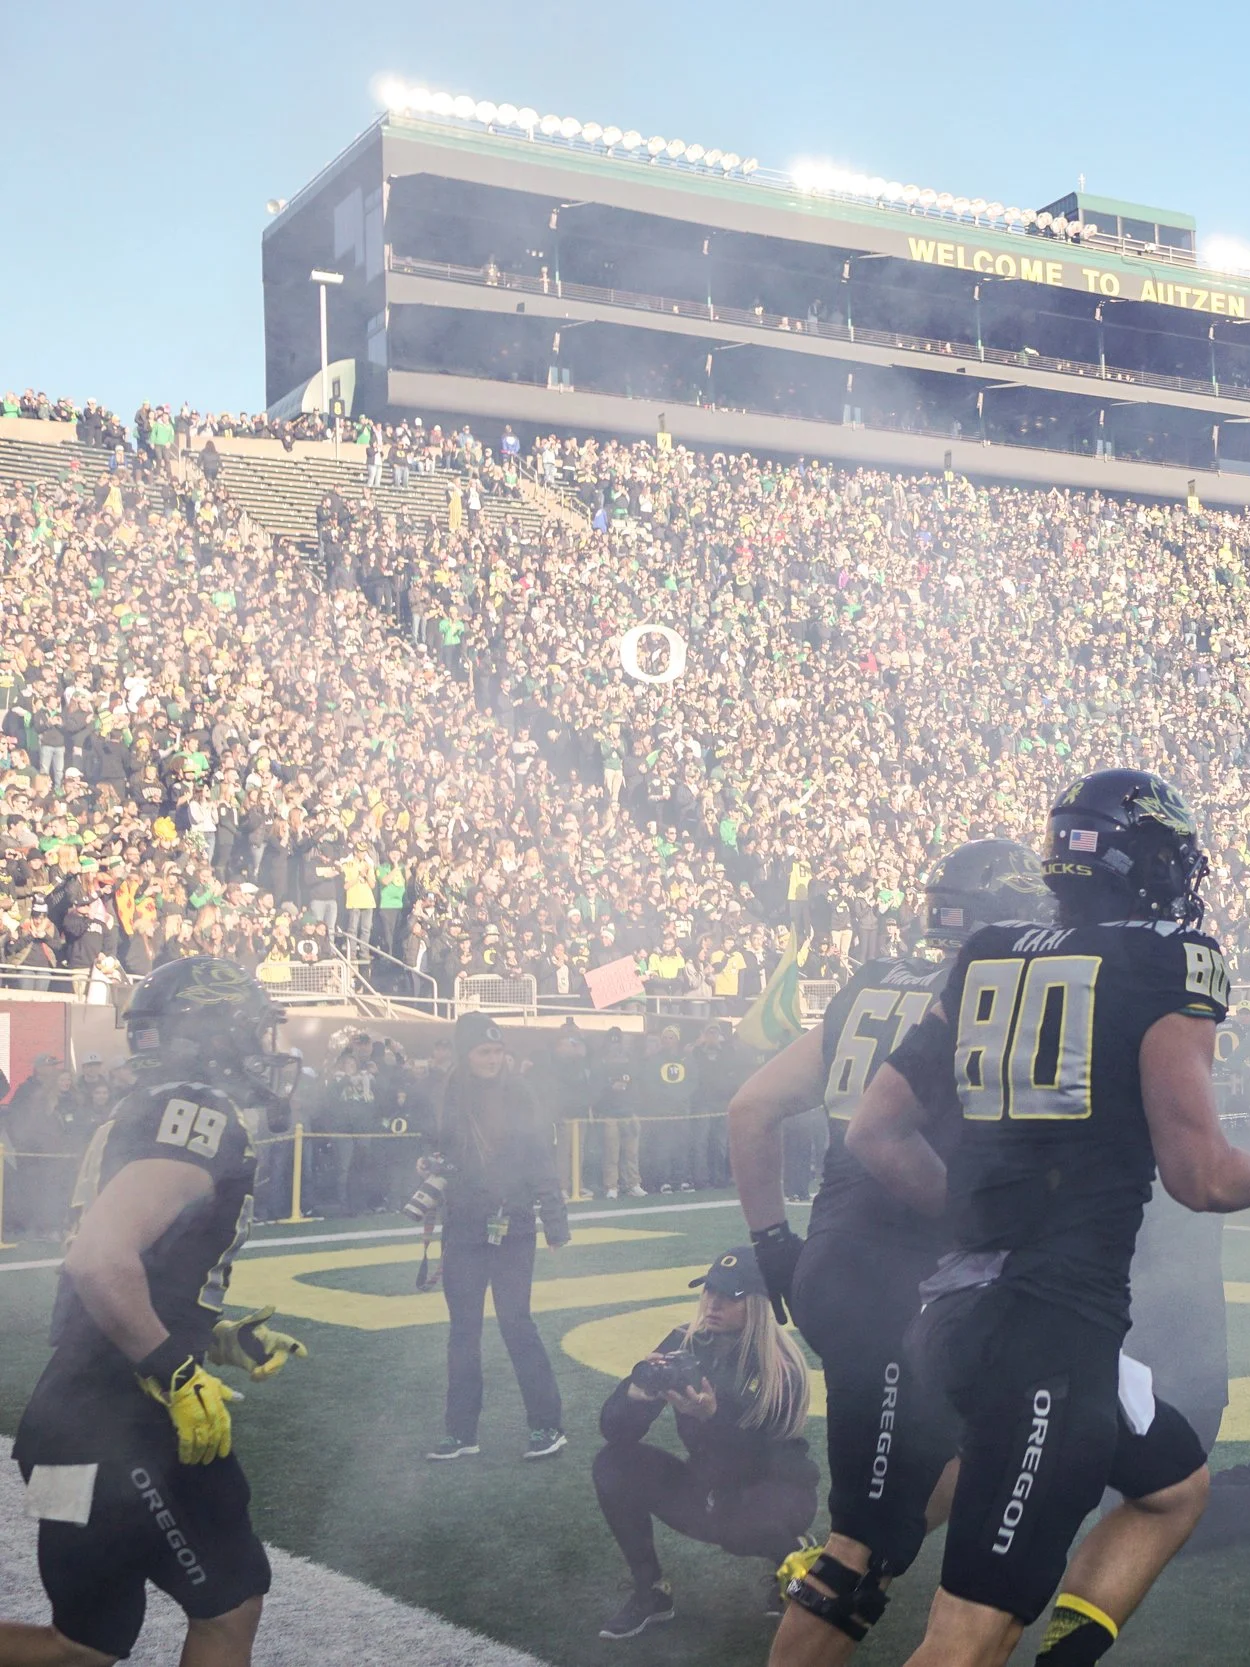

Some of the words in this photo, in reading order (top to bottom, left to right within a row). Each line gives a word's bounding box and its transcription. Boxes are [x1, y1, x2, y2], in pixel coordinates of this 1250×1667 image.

[908, 237, 1063, 287] WELCOME
[1083, 268, 1121, 297] TO
[1140, 279, 1246, 319] AUTZEN
[620, 624, 687, 683] O
[824, 988, 934, 1121] 61
[954, 954, 1103, 1121] 80
[155, 1097, 229, 1159] 89
[720, 1255, 738, 1267] O
[868, 1361, 901, 1500] OREGON
[991, 1388, 1053, 1556] OREGON
[130, 1466, 207, 1588] OREGON
